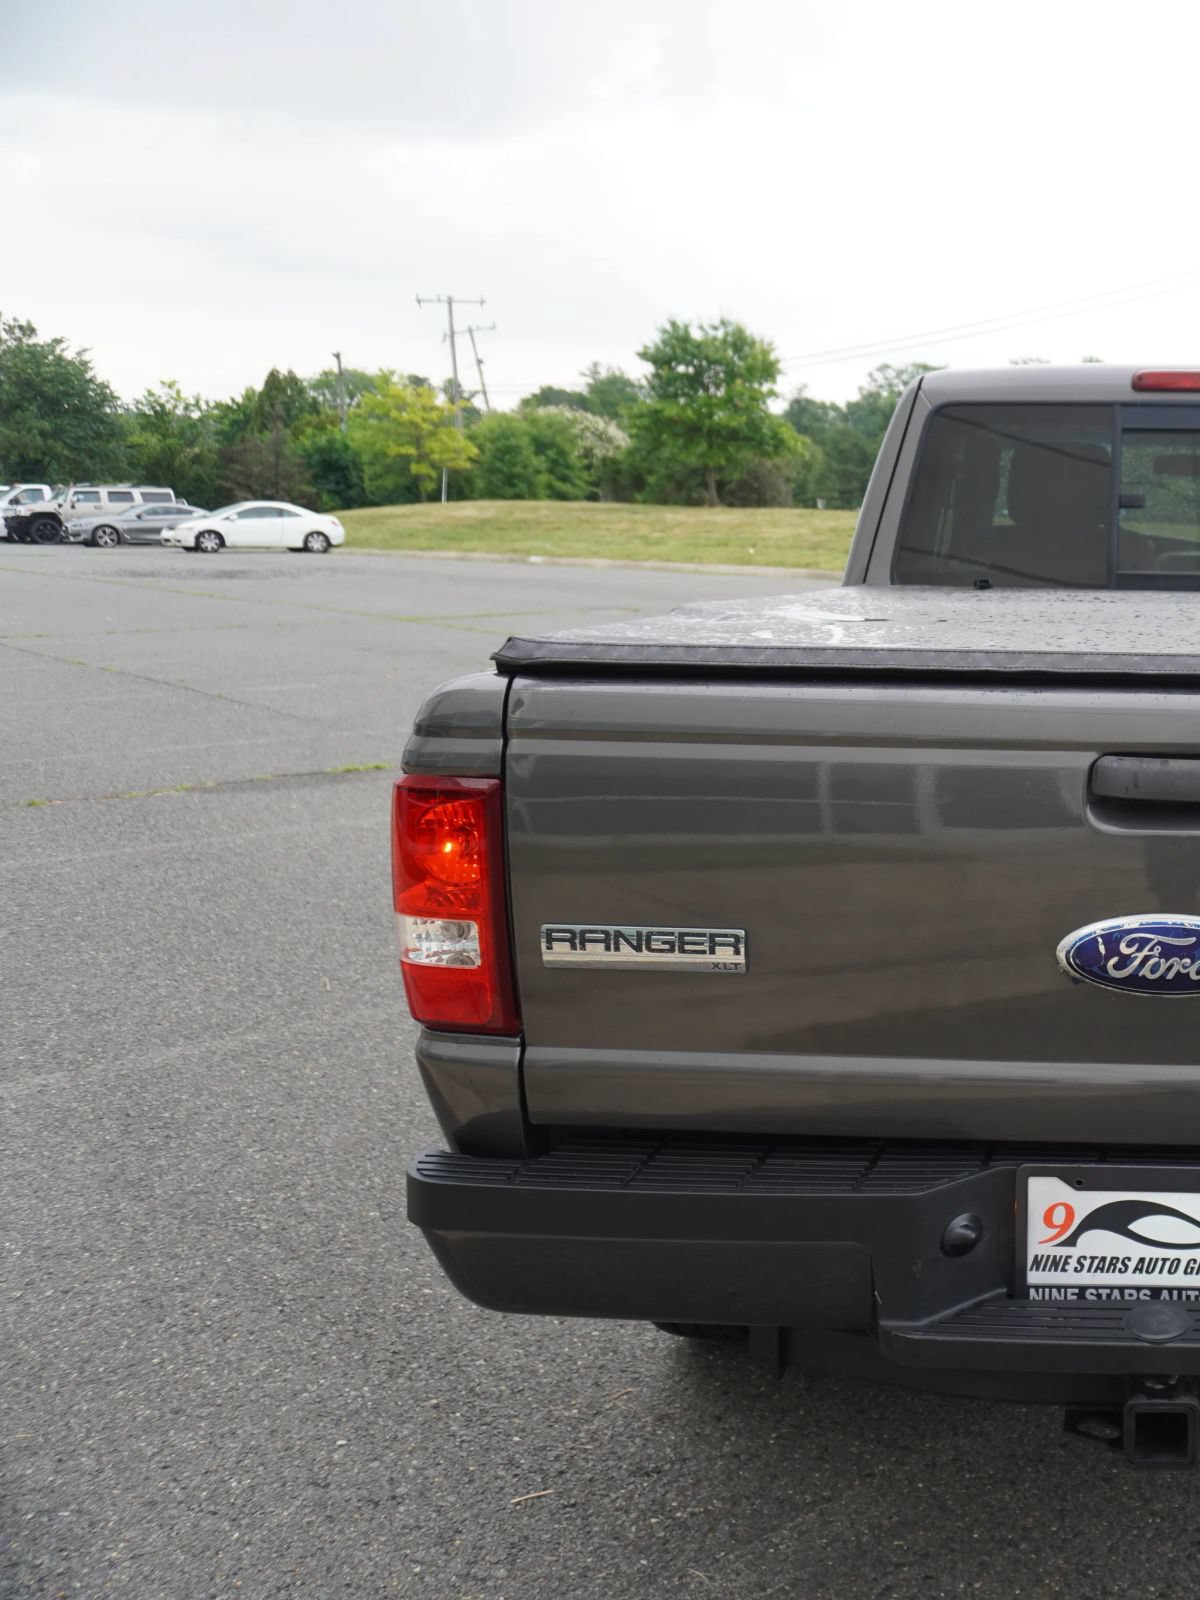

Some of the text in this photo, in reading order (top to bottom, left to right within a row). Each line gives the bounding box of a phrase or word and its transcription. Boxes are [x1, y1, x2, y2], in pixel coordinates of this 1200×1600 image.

[545, 928, 741, 956] RANGER
[711, 962, 742, 971] XLT
[1038, 1202, 1075, 1244] 9
[1029, 1254, 1073, 1273] NINE
[1073, 1255, 1131, 1274] STARS
[1132, 1257, 1182, 1276] AUTO
[1029, 1287, 1079, 1301] NINE
[1084, 1288, 1152, 1301] STARS
